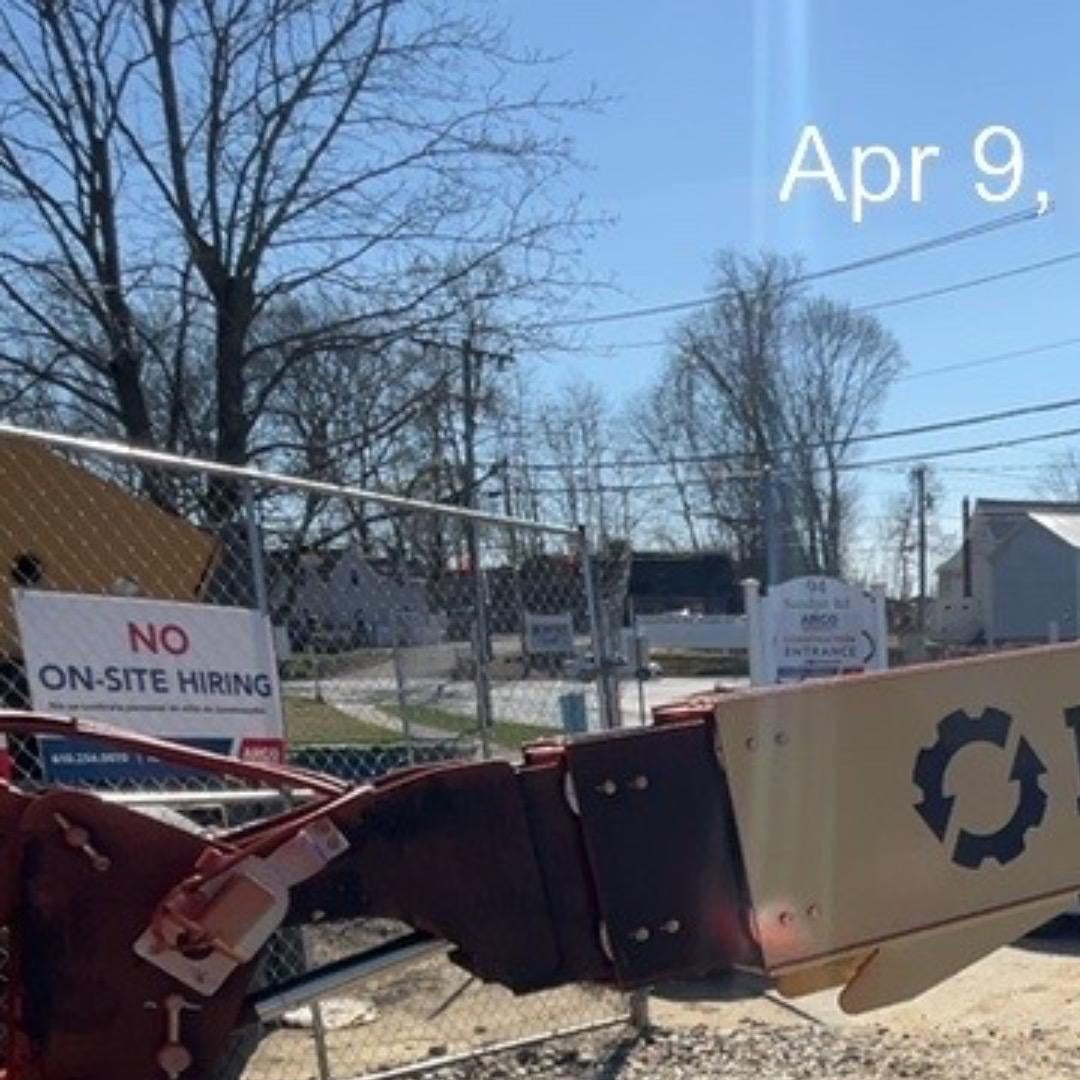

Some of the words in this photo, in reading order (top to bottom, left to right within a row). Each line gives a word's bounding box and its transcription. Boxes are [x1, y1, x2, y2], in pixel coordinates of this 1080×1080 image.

[127, 620, 191, 655] NO
[38, 664, 169, 694] ON-SITE
[178, 671, 272, 698] HIRING
